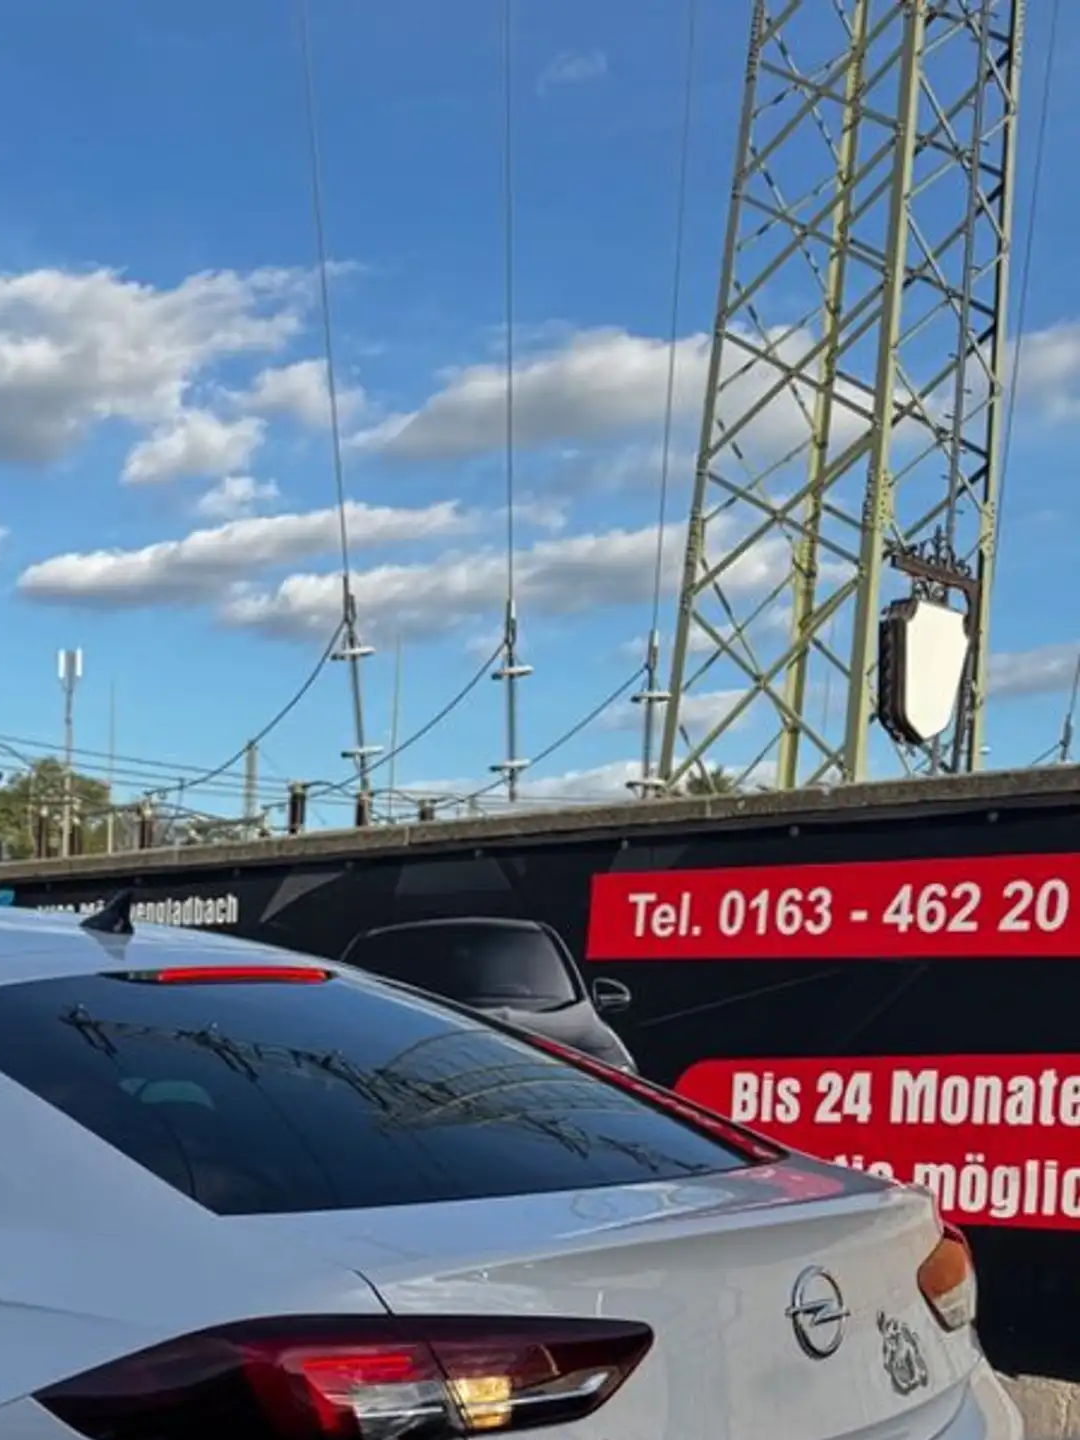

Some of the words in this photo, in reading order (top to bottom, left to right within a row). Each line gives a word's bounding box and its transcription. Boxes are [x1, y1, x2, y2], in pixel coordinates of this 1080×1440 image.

[628, 892, 702, 938] Tel.
[719, 886, 833, 937] 0163
[849, 909, 869, 923] -
[882, 882, 982, 934] 462
[997, 877, 1070, 932] 20
[731, 1072, 802, 1123] Bis
[814, 1070, 873, 1124] 24
[889, 1068, 1080, 1127] Monate
